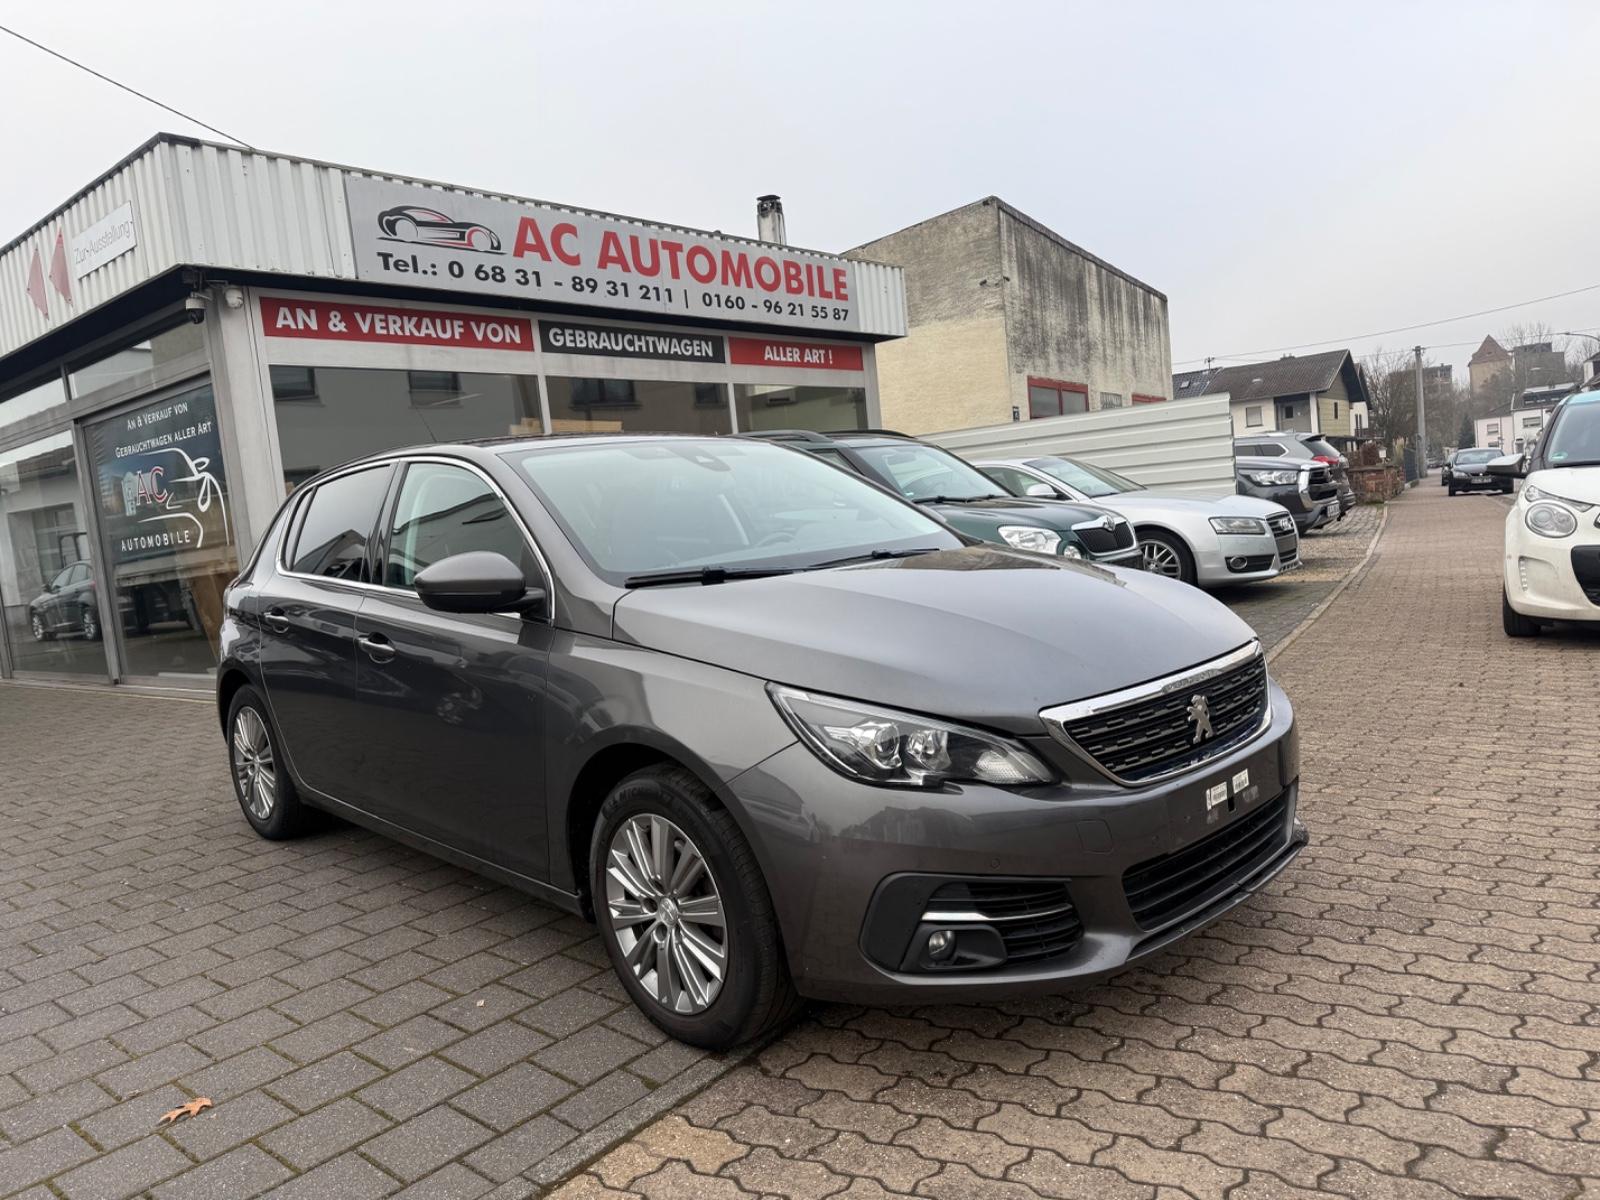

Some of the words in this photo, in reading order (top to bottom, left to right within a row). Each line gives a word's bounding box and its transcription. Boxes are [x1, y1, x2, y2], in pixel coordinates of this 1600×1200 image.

[512, 215, 581, 267] AC
[597, 230, 849, 302] AUTOMOBILE
[376, 251, 438, 276] Tel.:
[448, 260, 464, 279] 0
[474, 264, 506, 284] 68
[514, 269, 542, 288] 31
[571, 276, 598, 294] 89
[606, 280, 630, 298] 31
[639, 285, 673, 303] 211
[702, 292, 745, 310] 0160
[763, 299, 783, 315] 96
[788, 303, 804, 317] 21
[811, 305, 828, 320] 55
[833, 308, 849, 322] 87
[275, 306, 318, 331] AN
[327, 310, 348, 333] &
[353, 311, 465, 340] VERKAUF
[469, 321, 522, 345] VON
[549, 327, 713, 358] GEBRAUCHTWAGEN
[764, 345, 801, 363] ALLER
[803, 348, 825, 364] ART
[174, 426, 196, 441] ALLER
[136, 465, 168, 506] AC
[121, 529, 191, 552] AUTOMOBILE
